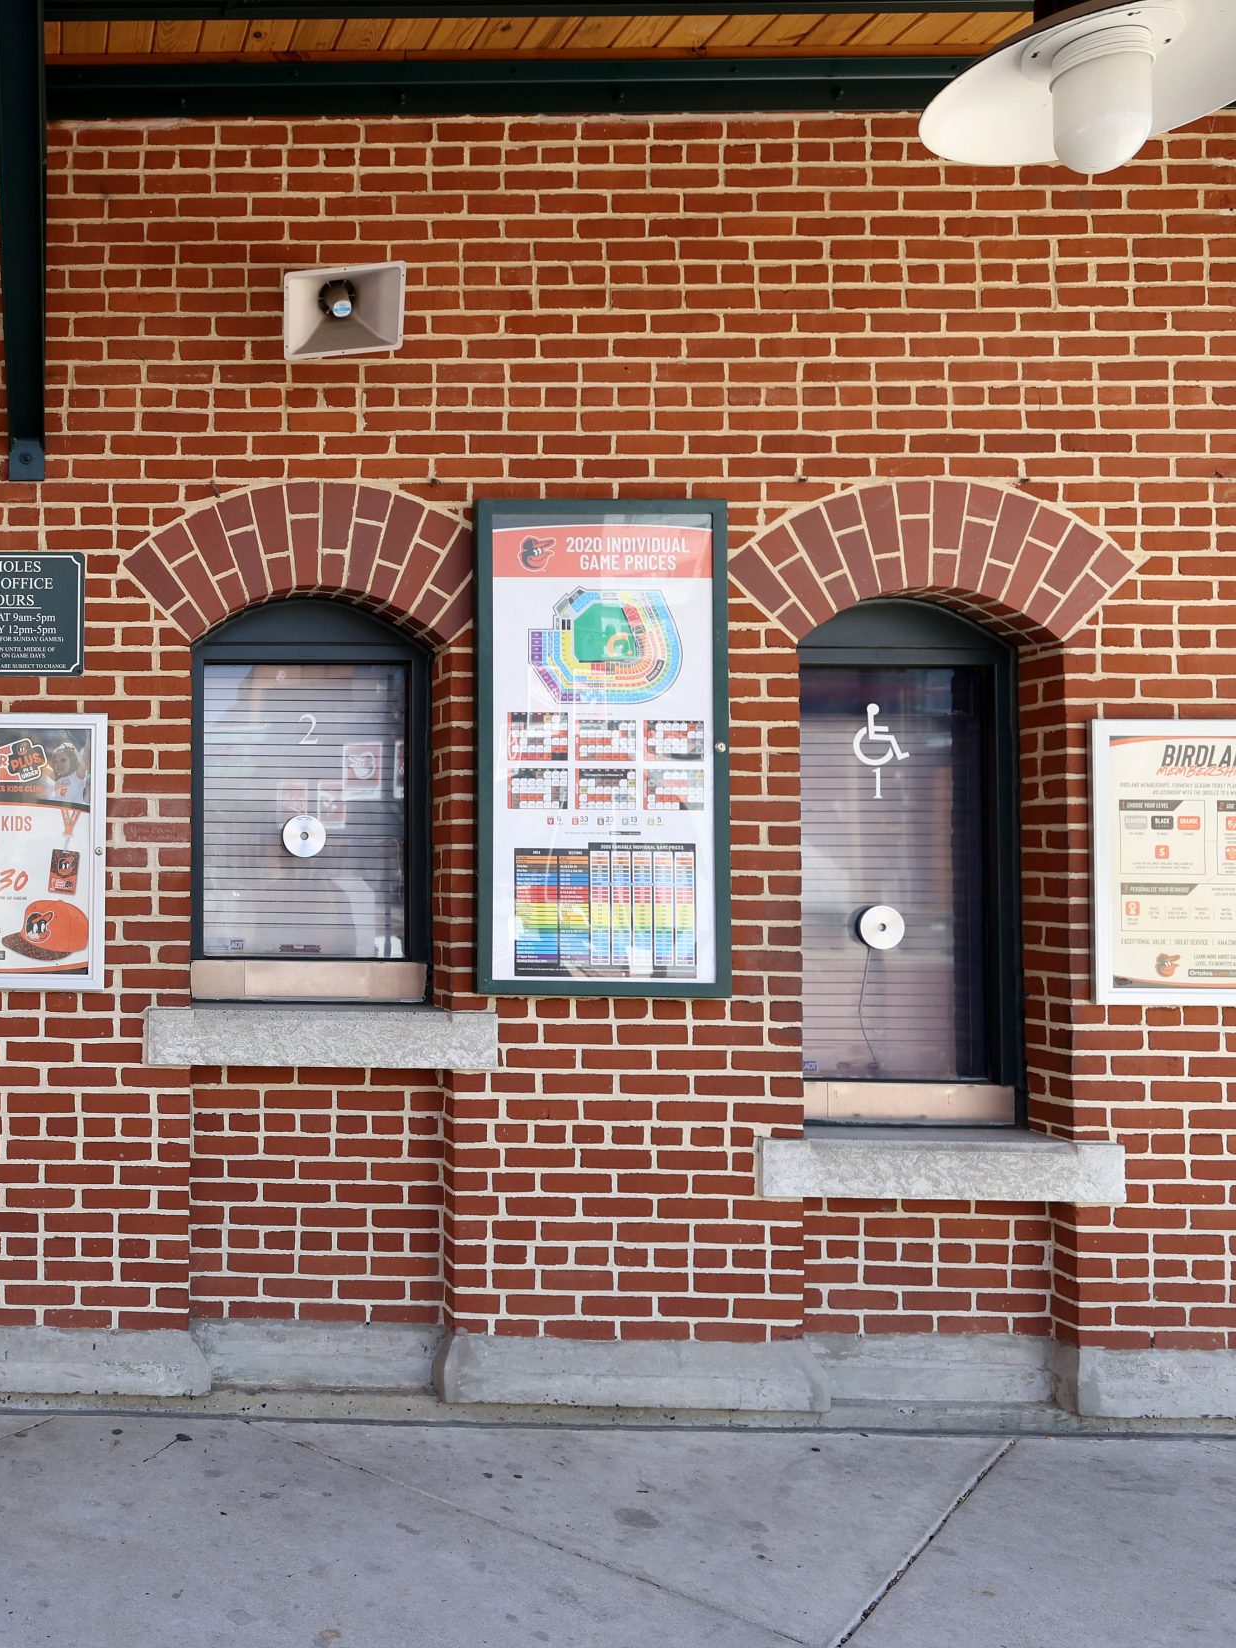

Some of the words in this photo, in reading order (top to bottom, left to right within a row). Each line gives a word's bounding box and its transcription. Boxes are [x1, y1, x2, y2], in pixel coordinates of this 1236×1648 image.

[566, 537, 602, 553] 2020
[607, 537, 690, 553] INDIVIDUAL
[580, 555, 620, 570] GAME
[625, 555, 676, 570] PRICES
[1, 577, 53, 589] OFFICE
[13, 613, 56, 624] 9am-5pm
[9, 625, 56, 636] 12pm-5pm
[298, 713, 319, 745] 2
[11, 752, 42, 770] PLUS
[21, 770, 39, 778] UNDER
[871, 767, 883, 799] 1
[1, 815, 32, 831] KIDS
[230, 941, 243, 949] ADT
